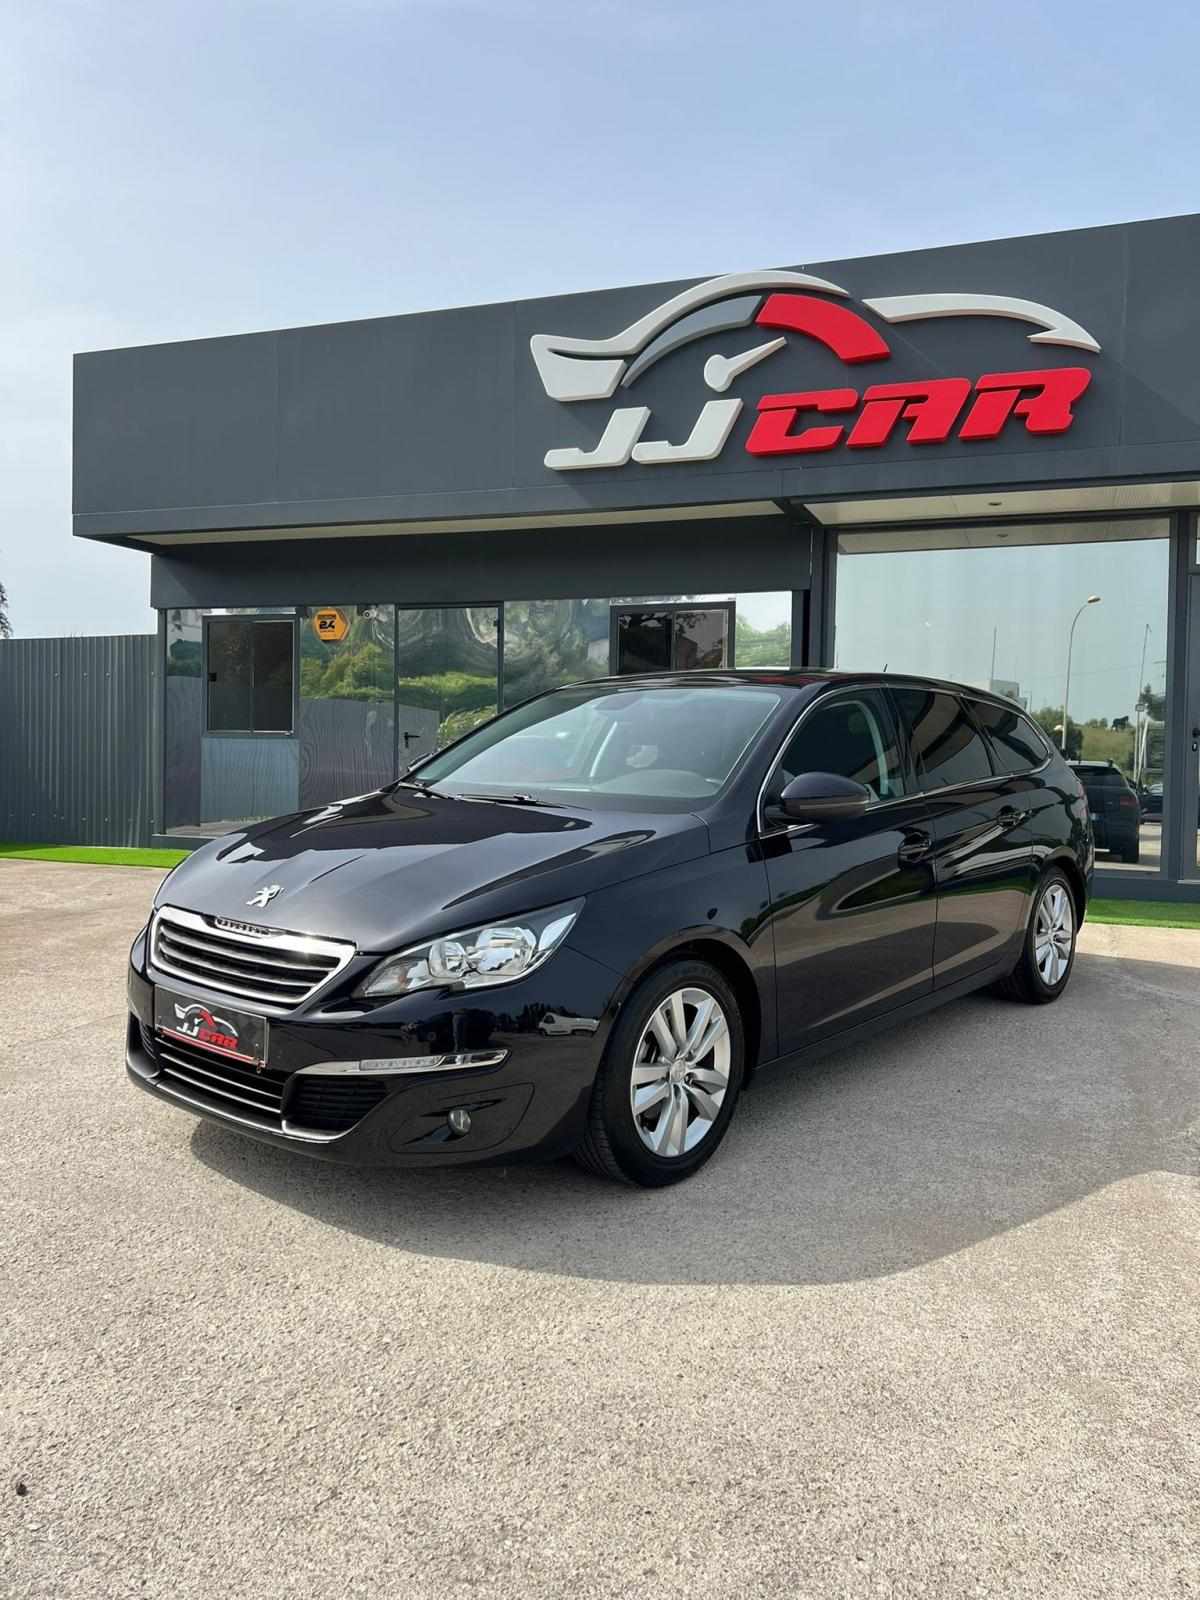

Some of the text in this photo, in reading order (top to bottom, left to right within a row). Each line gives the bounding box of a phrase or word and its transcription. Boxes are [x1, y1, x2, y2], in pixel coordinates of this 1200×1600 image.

[544, 367, 1093, 471] JJ CAR
[199, 1028, 238, 1049] CAR
